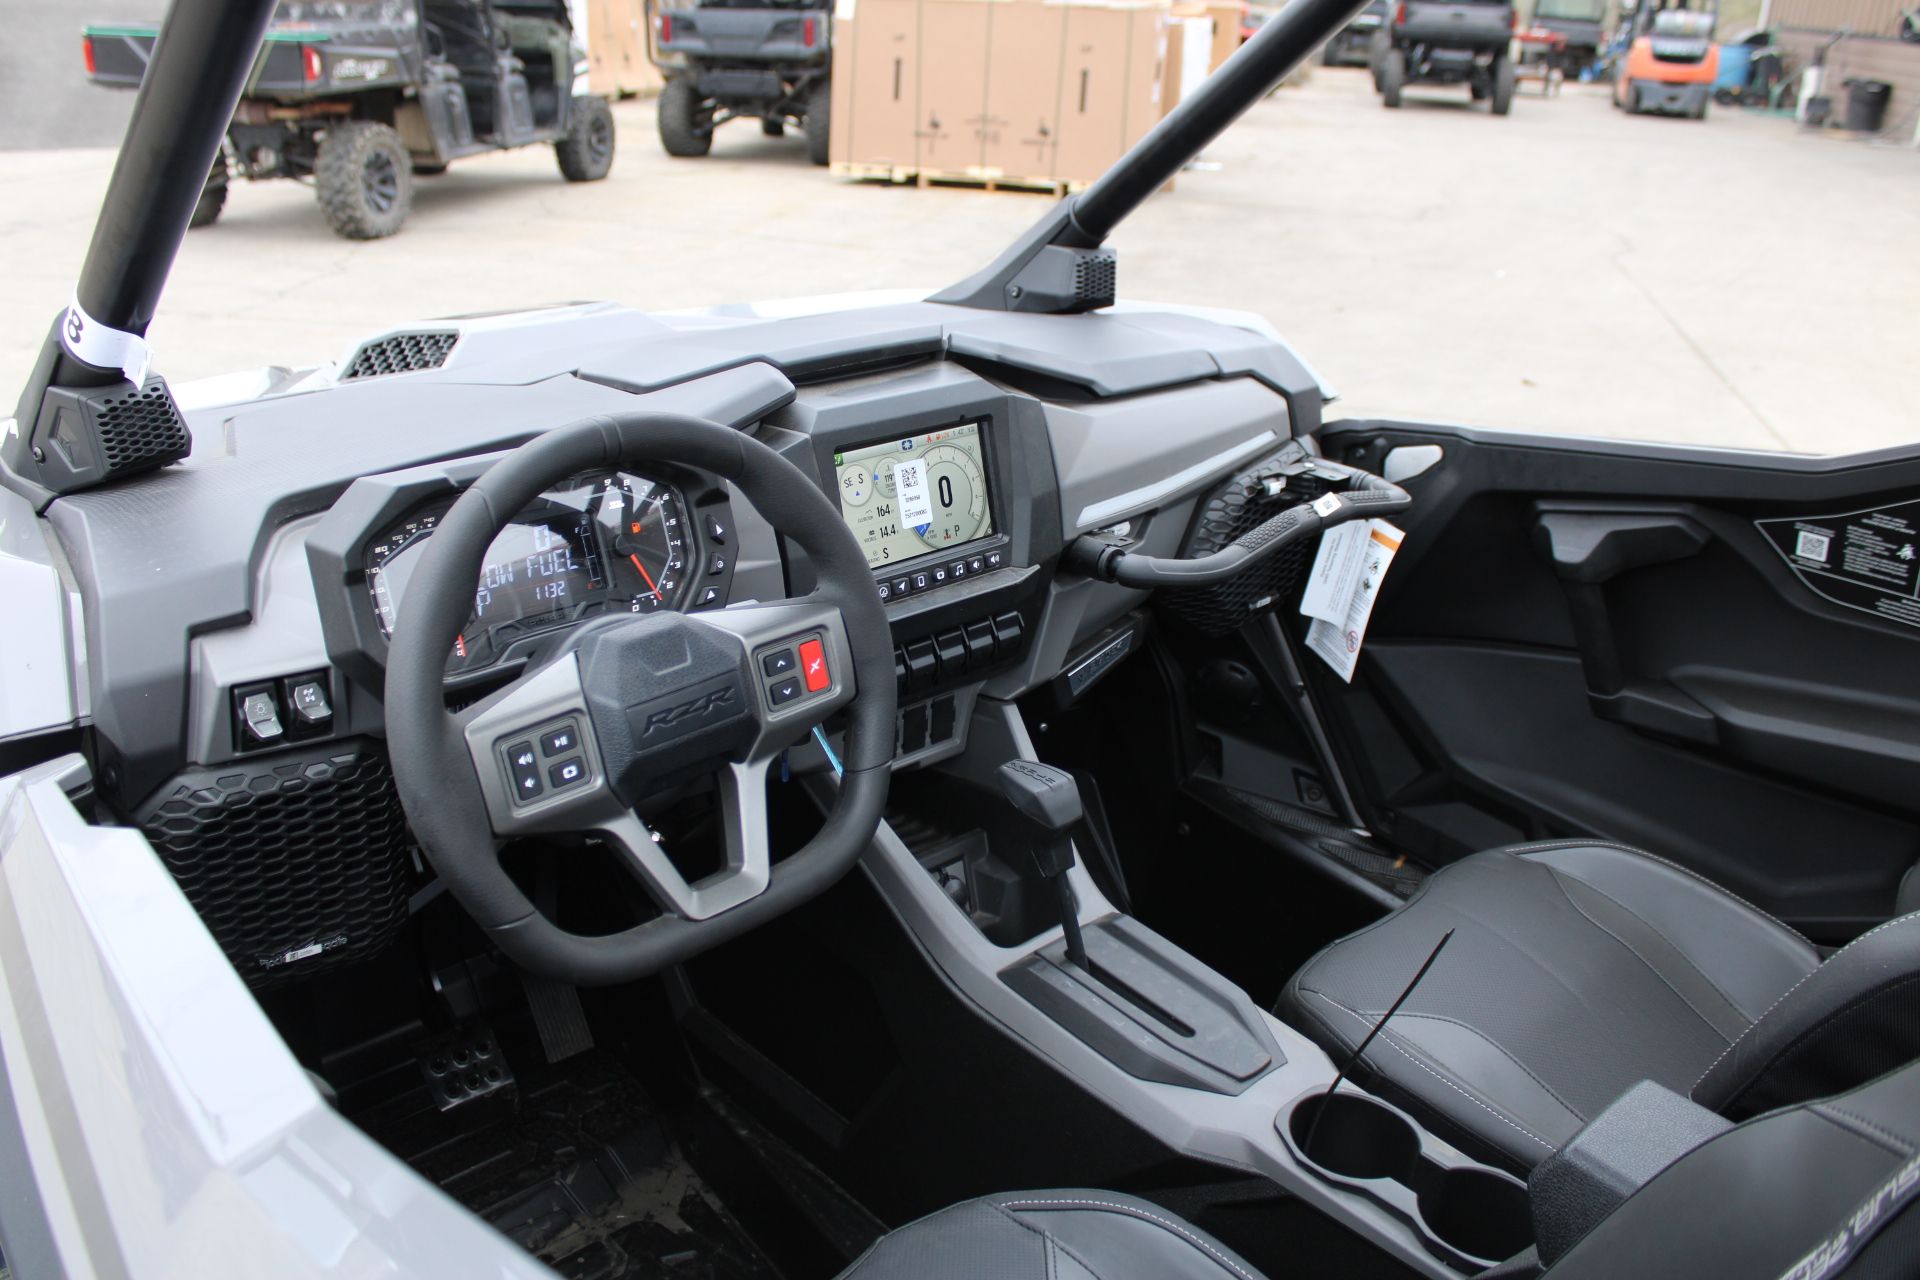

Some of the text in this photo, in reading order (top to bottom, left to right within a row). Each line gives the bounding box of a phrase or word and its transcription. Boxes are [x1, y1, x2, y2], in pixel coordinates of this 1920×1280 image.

[843, 476, 854, 489] SE
[858, 473, 864, 485] S
[938, 475, 953, 508] 0
[876, 503, 891, 518] 164
[879, 523, 896, 538] 14.4
[954, 524, 960, 537] P
[882, 547, 889, 559] S
[526, 548, 579, 578] FUEL
[536, 580, 566, 601] 1132
[476, 590, 491, 617] P
[641, 685, 736, 739] RZR
